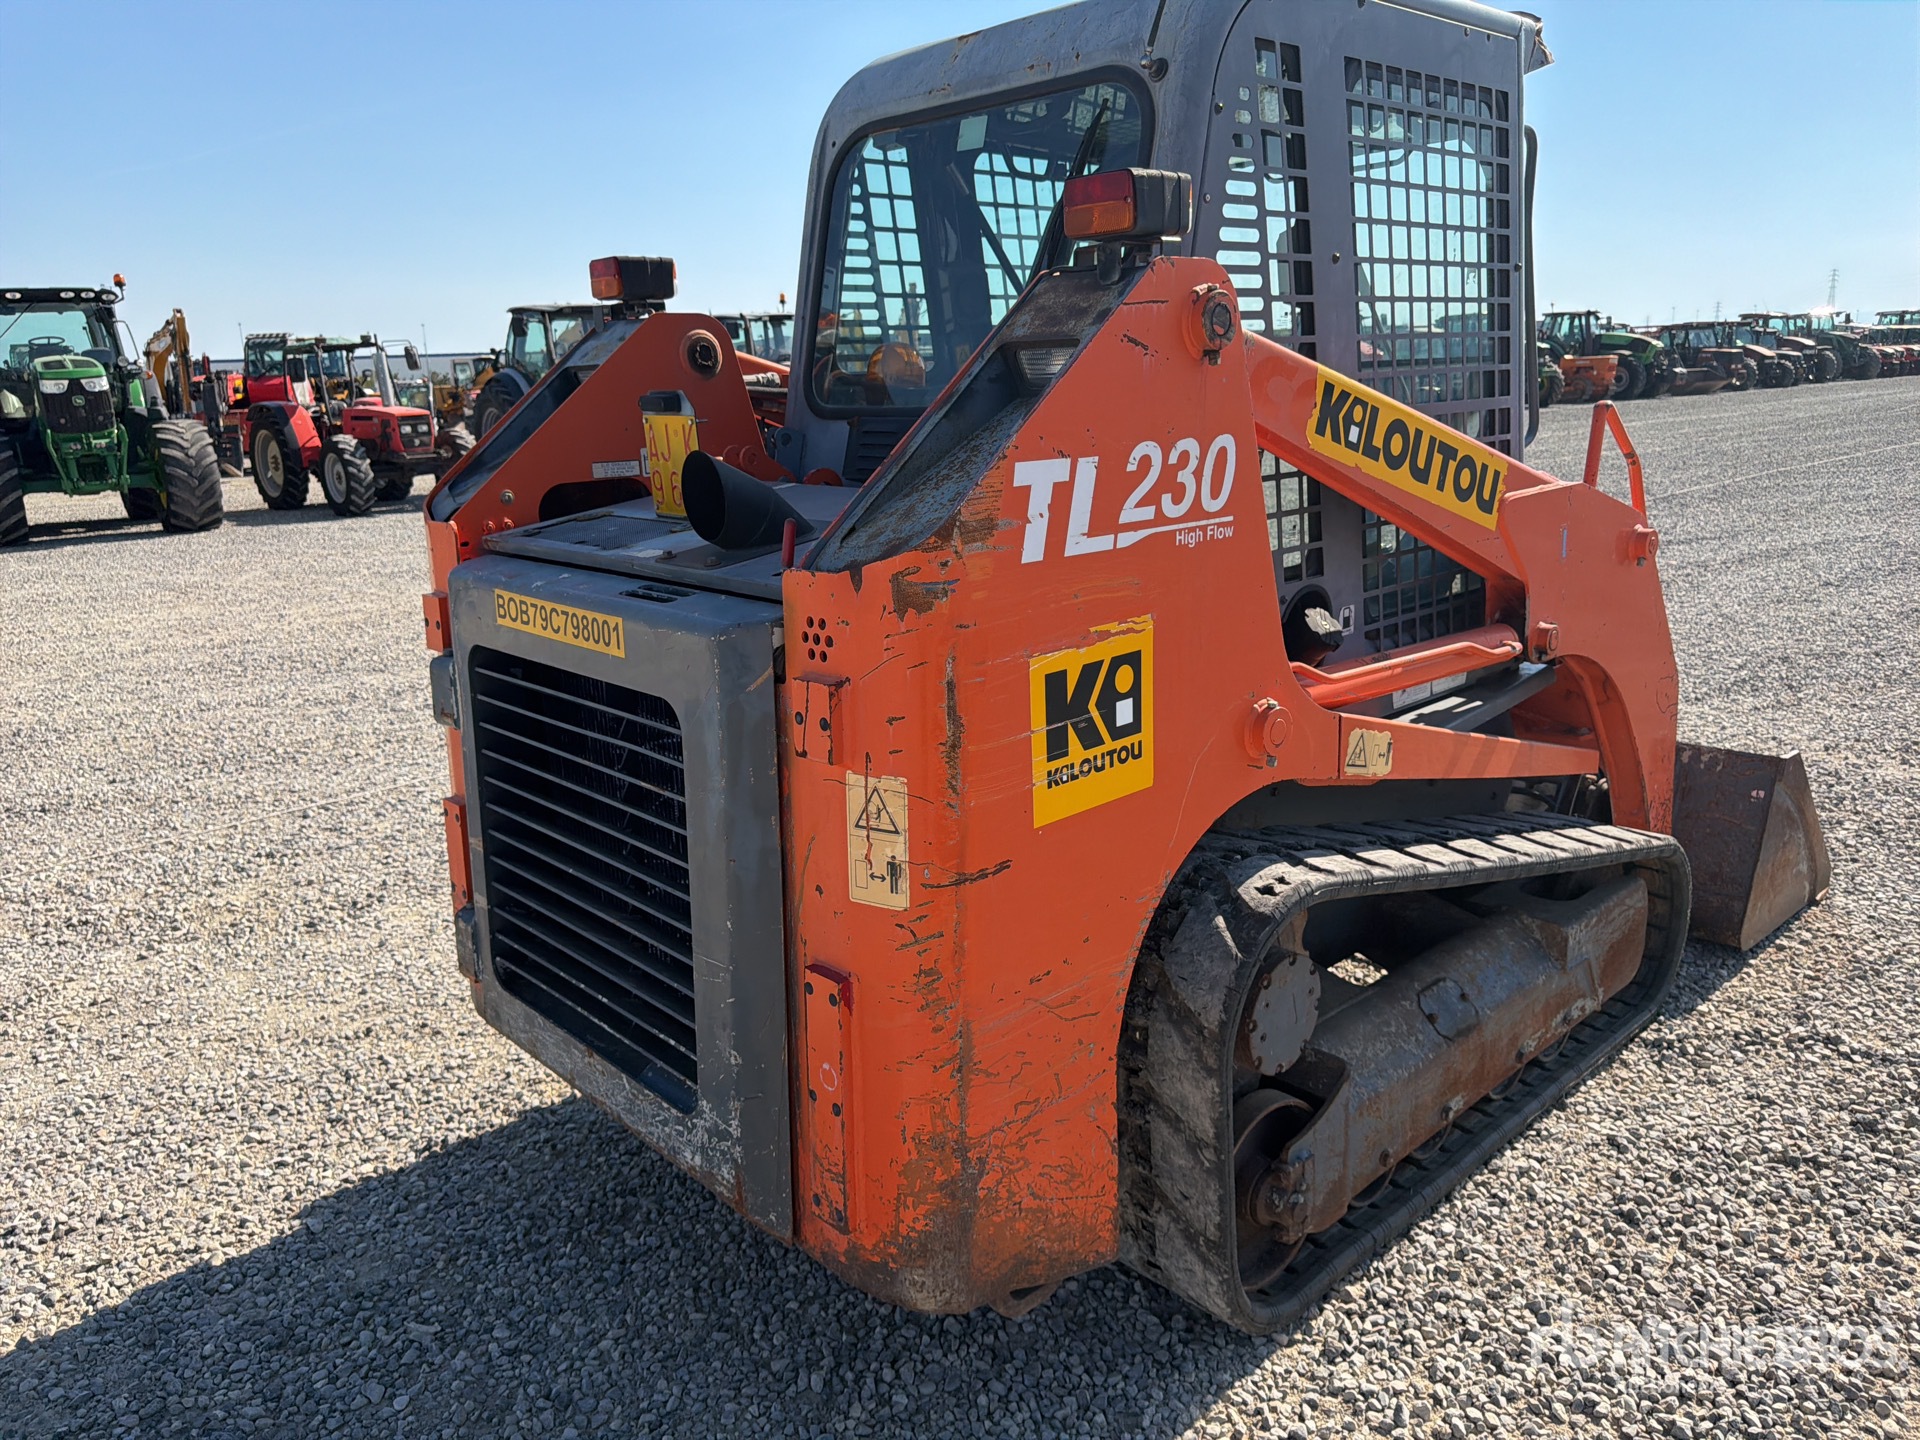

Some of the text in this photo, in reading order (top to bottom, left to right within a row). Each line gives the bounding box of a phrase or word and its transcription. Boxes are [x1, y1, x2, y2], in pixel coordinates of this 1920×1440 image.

[1013, 433, 1236, 564] TL 230
[1175, 525, 1234, 548] High Flow
